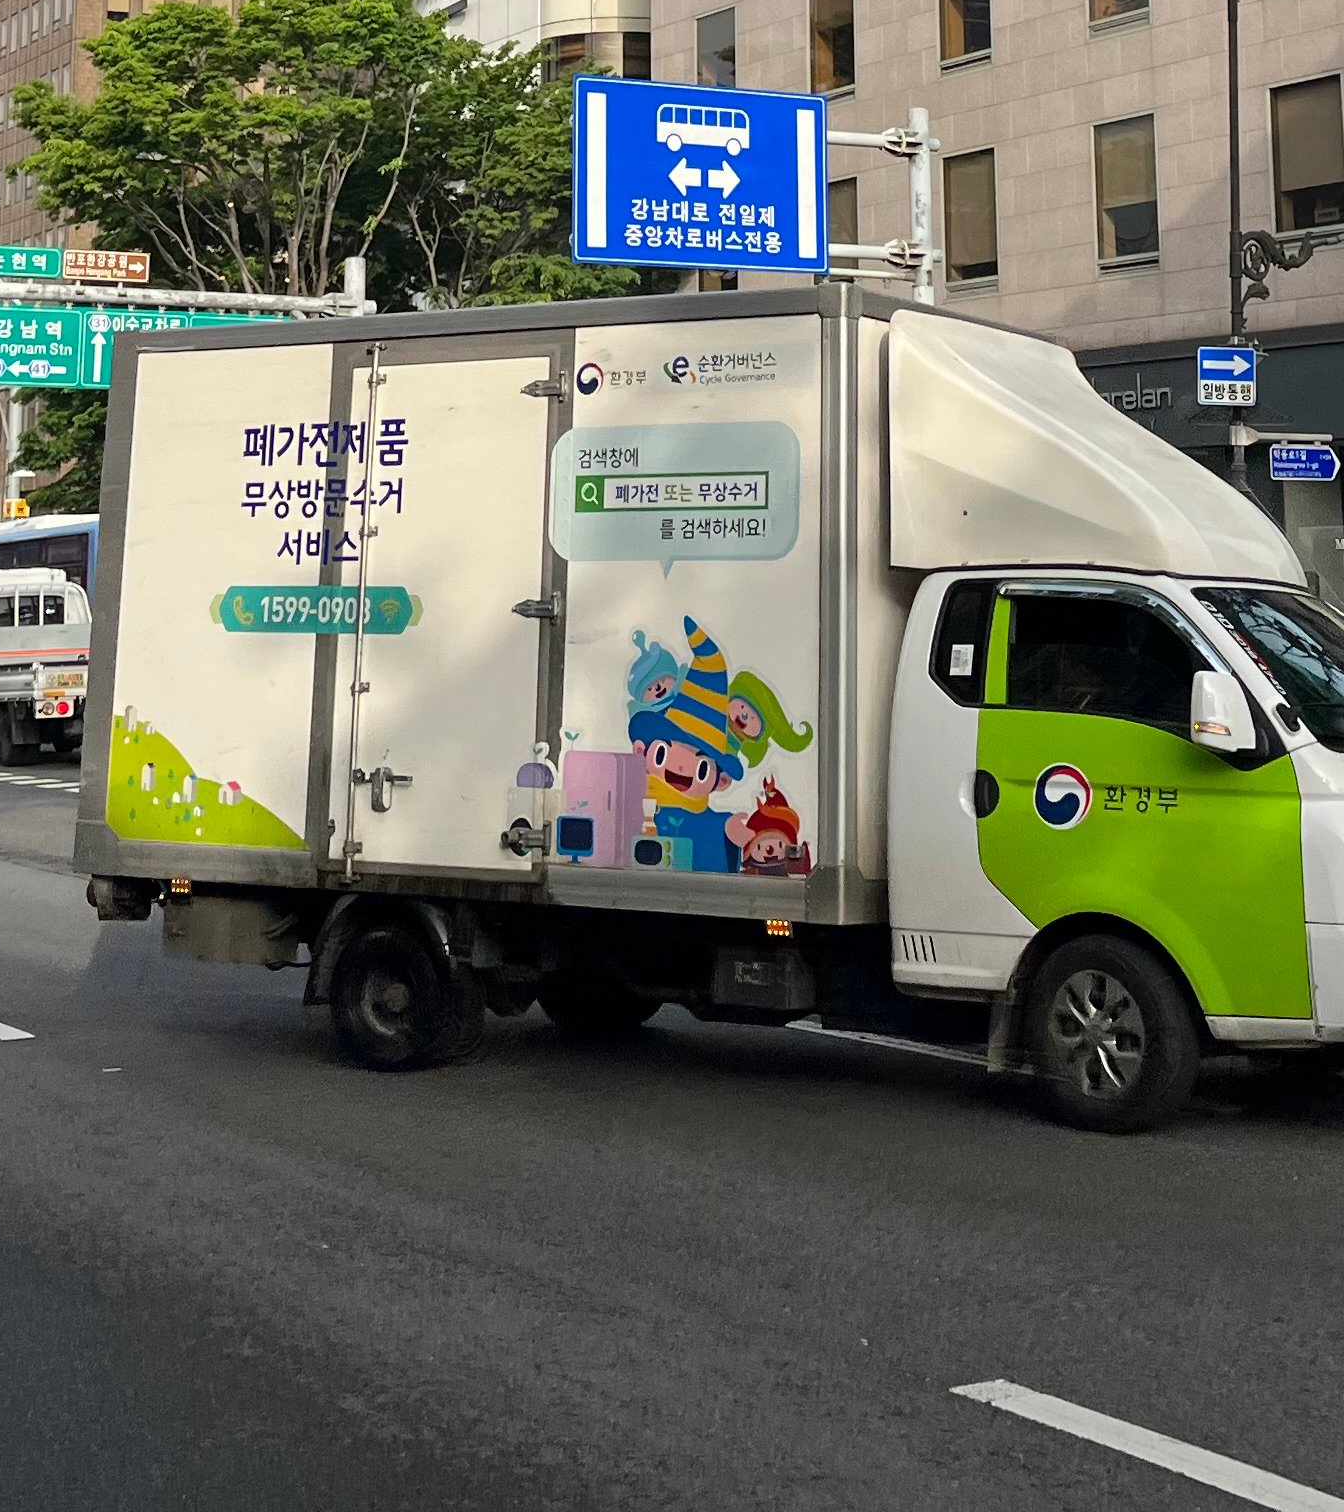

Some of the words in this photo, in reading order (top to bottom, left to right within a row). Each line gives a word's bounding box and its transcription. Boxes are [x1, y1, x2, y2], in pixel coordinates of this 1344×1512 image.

[631, 198, 710, 223] 강남대로
[719, 203, 776, 228] 전일제
[624, 224, 783, 254] 중앙차로버스전용
[94, 317, 106, 328] 31
[50, 342, 73, 356] Stn
[31, 363, 47, 375] 41
[697, 352, 777, 373] 순환거버넌스
[609, 370, 647, 385] 환경부
[699, 374, 722, 386] Cycle
[724, 372, 776, 383] Governance
[1203, 382, 1252, 402] 일방통행
[243, 418, 408, 467] 폐가전제품
[578, 448, 639, 469] 검색창에
[241, 477, 403, 518] 무상방문수거
[615, 483, 659, 503] 폐가전
[664, 484, 693, 503] 또는
[698, 482, 758, 502] 무상수거
[660, 519, 675, 539] 를
[681, 518, 766, 539] 검색하세요!
[277, 529, 359, 565] 서비스
[1104, 785, 1178, 814] 환경부
